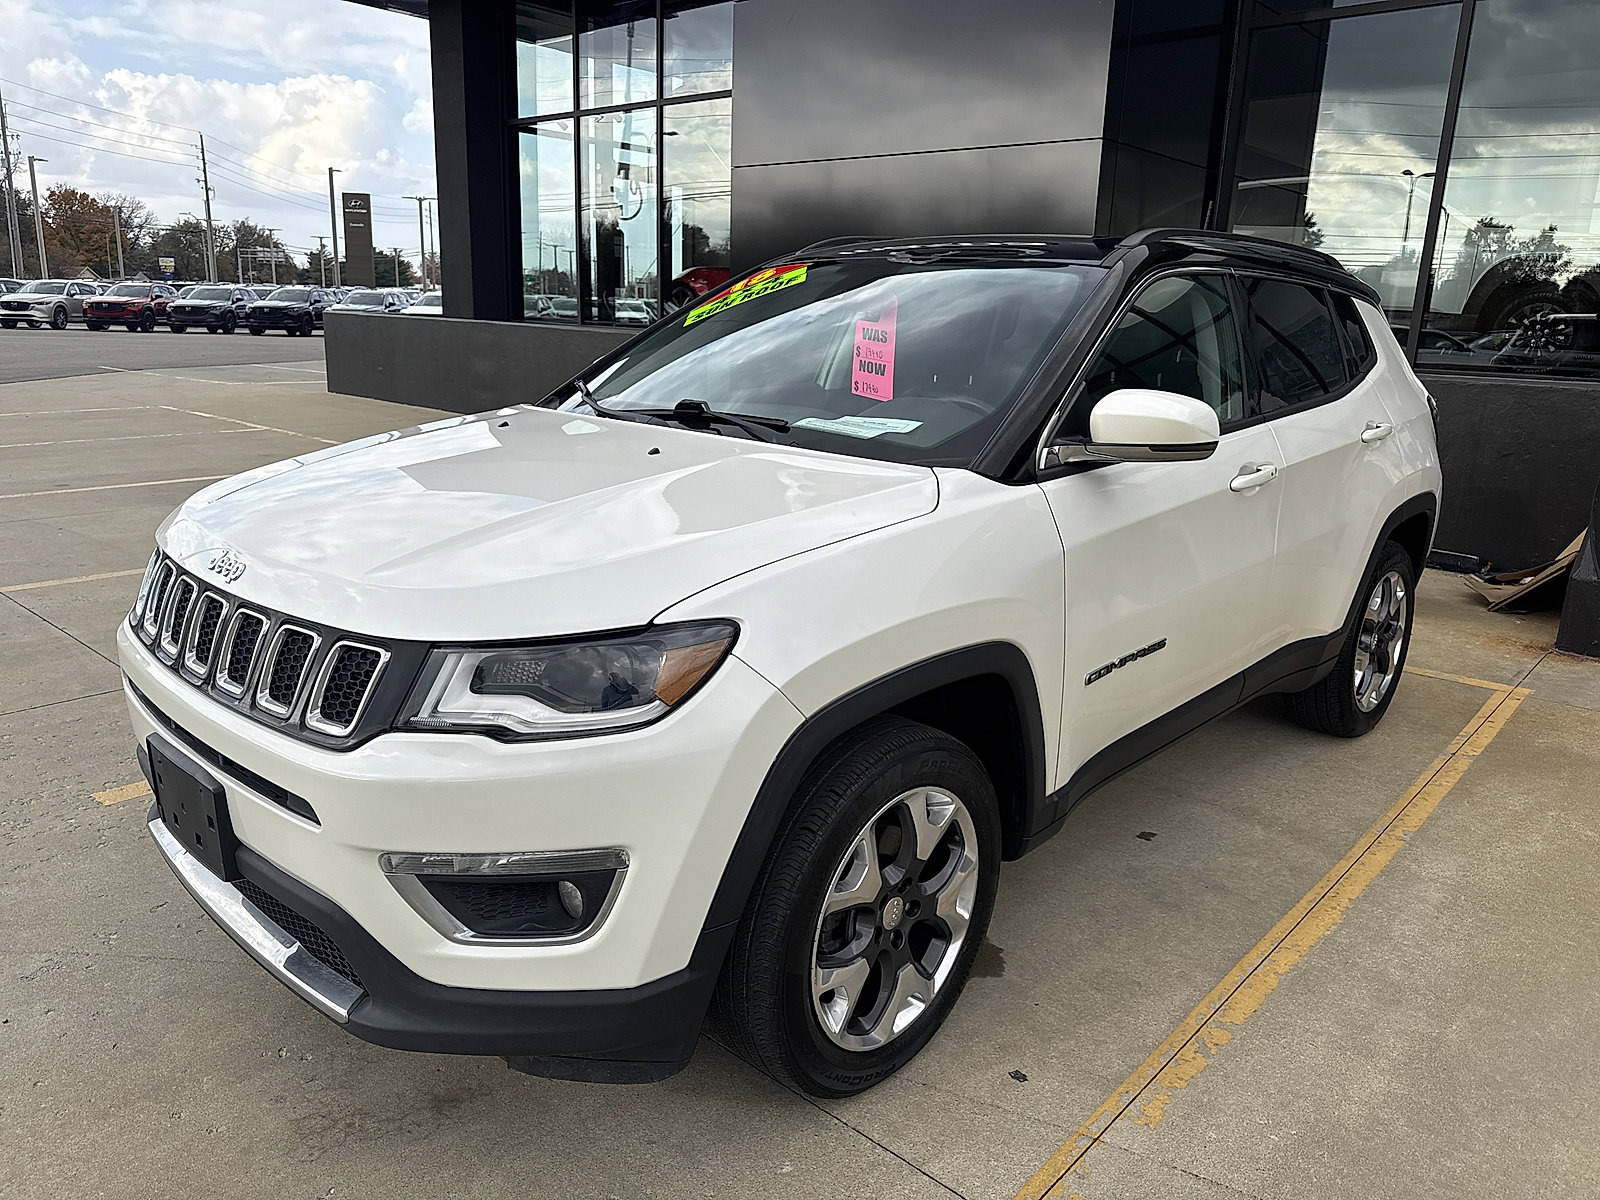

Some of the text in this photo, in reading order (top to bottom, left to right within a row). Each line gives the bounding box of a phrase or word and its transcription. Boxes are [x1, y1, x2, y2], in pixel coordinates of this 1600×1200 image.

[862, 327, 888, 344] WAS
[855, 345, 861, 358] $
[859, 359, 887, 377] NOW
[854, 380, 860, 393] $
[208, 549, 247, 585] Jeep
[1084, 637, 1168, 686] COMPASS
